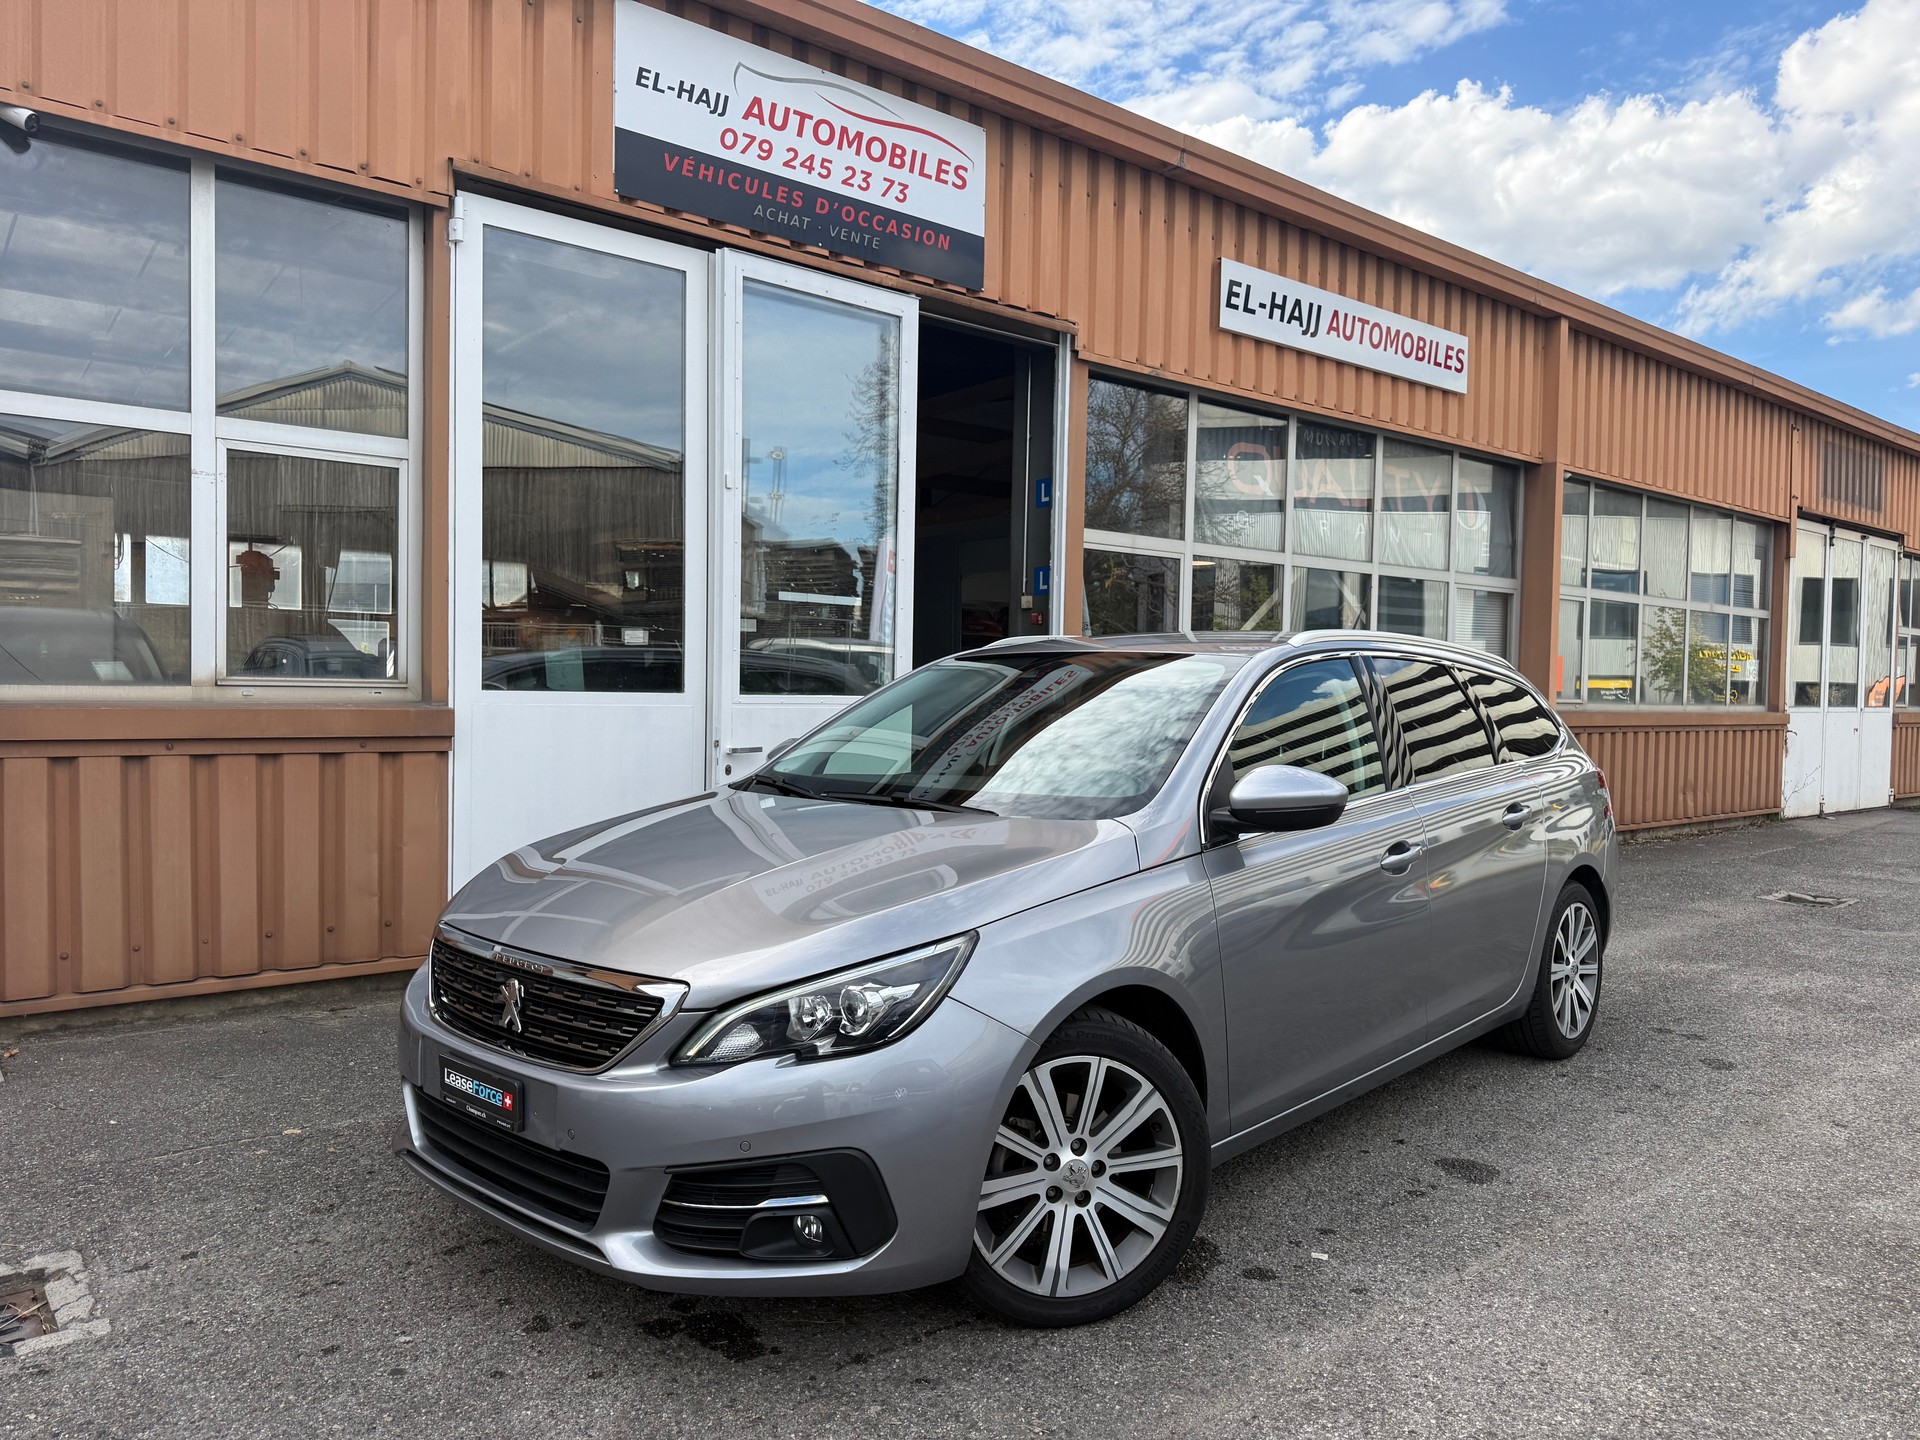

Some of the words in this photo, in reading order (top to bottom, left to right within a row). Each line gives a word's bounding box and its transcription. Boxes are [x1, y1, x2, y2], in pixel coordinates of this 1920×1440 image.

[635, 66, 730, 118] EL-HAJJ
[719, 127, 773, 161] 079
[782, 147, 833, 180] 245
[841, 165, 873, 192] 23
[881, 177, 910, 204] 73
[741, 95, 969, 190] AUTOMOBILES
[664, 153, 804, 208] VÉHICULES
[815, 197, 951, 251] D'OCCASION
[753, 204, 812, 230] ACHAT
[829, 225, 881, 250] VENTE
[1225, 279, 1322, 338] EL-HAJJ
[1326, 309, 1465, 374] AUTOMOBILES
[1040, 482, 1050, 503] L
[1039, 571, 1048, 590] L
[495, 953, 545, 973] PEUGEOT
[444, 1067, 503, 1105] LeaseForce
